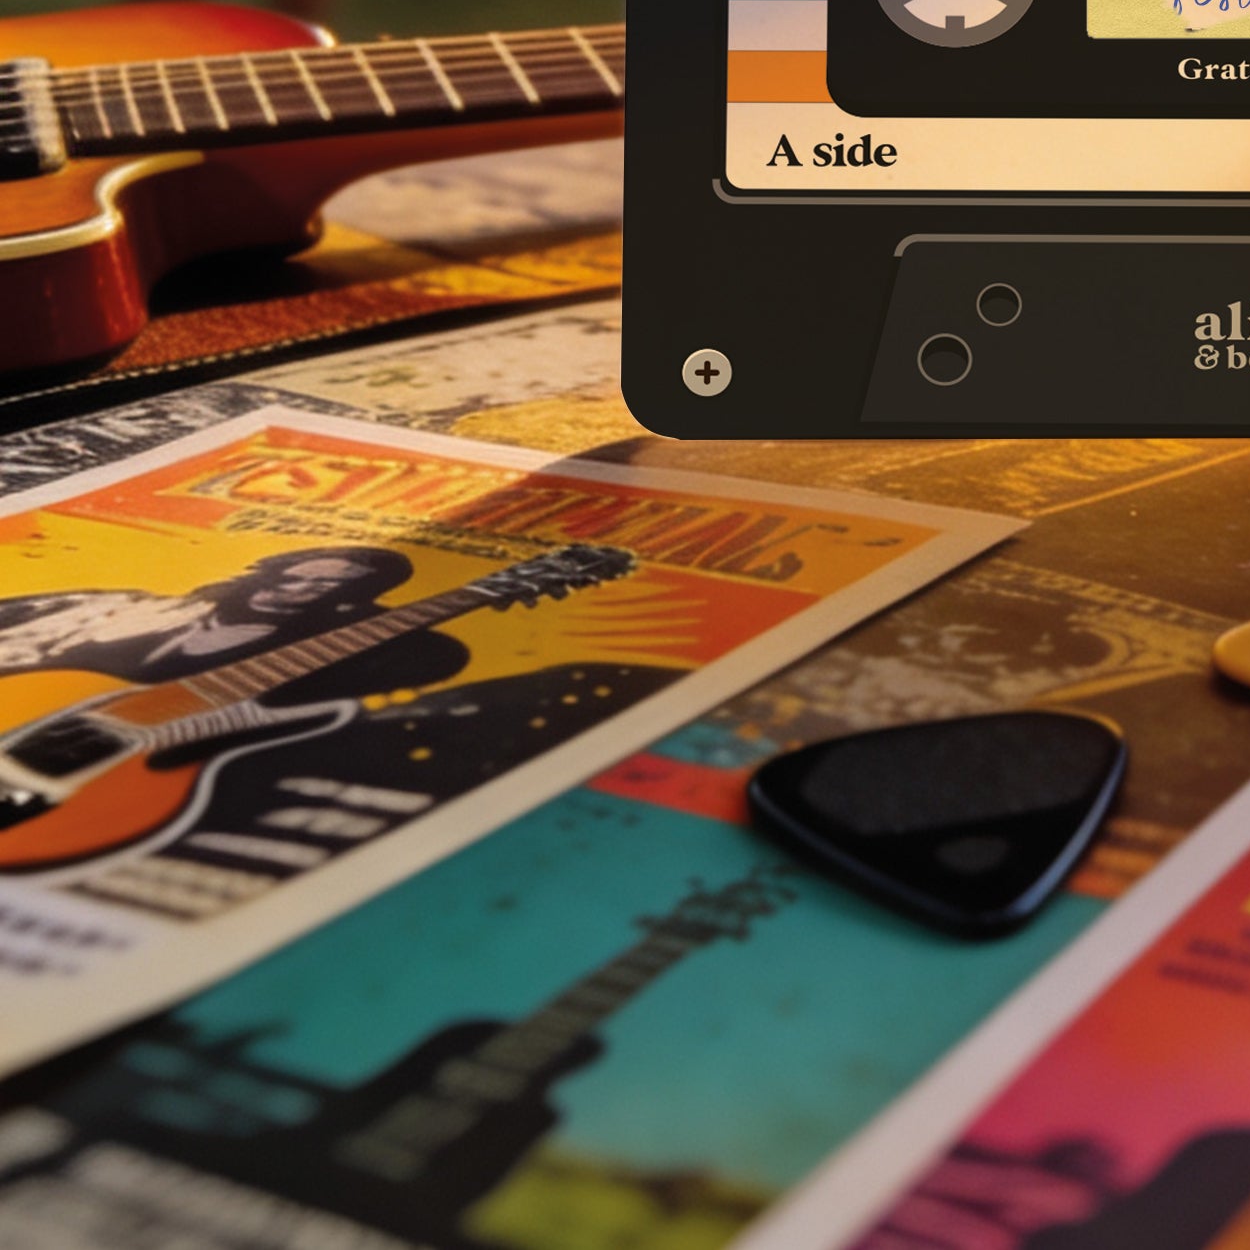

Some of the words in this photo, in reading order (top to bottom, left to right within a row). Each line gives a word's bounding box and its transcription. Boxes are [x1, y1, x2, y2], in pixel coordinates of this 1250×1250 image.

[766, 132, 804, 167] A
[812, 132, 898, 168] side
[1193, 344, 1220, 370] &
